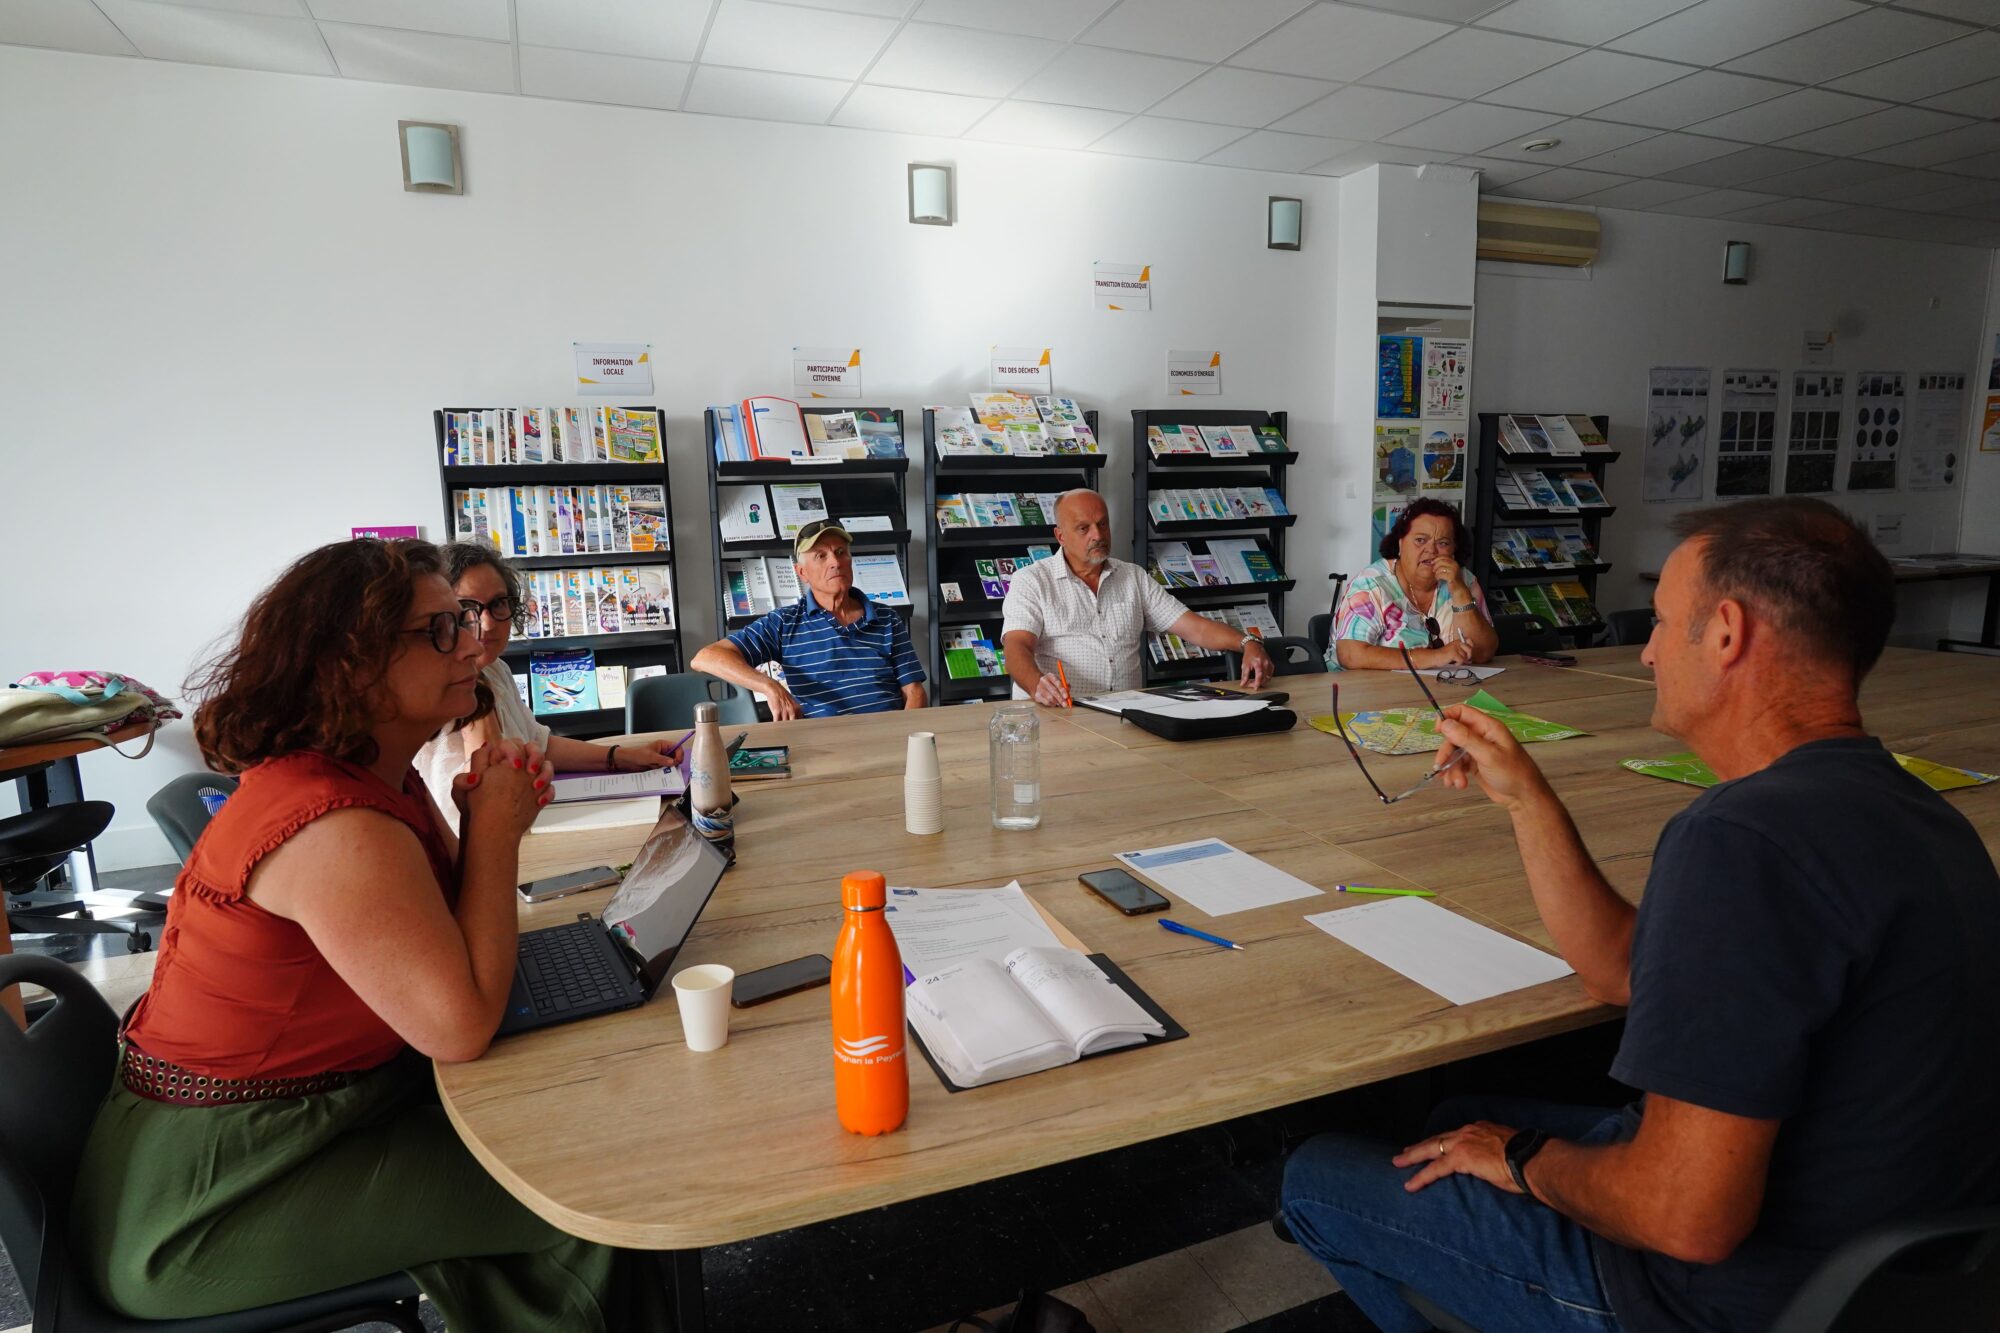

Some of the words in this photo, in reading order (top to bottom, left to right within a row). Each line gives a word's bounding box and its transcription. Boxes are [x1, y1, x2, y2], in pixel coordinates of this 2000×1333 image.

[1095, 280, 1120, 288] TRANSITION
[1120, 280, 1147, 290] ÉCOLOGIQUE
[592, 358, 633, 366] INFORMATION
[603, 368, 624, 376] LOCALE
[807, 365, 847, 373] PARTICIPATION
[998, 366, 1007, 374] TRI
[1008, 366, 1018, 374] DES
[1018, 365, 1040, 374] DÉCHETS
[812, 374, 841, 382] CITOYENNE
[991, 584, 1001, 595] A
[1006, 959, 1016, 974] 25
[925, 976, 939, 985] 24
[865, 1057, 874, 1065] la
